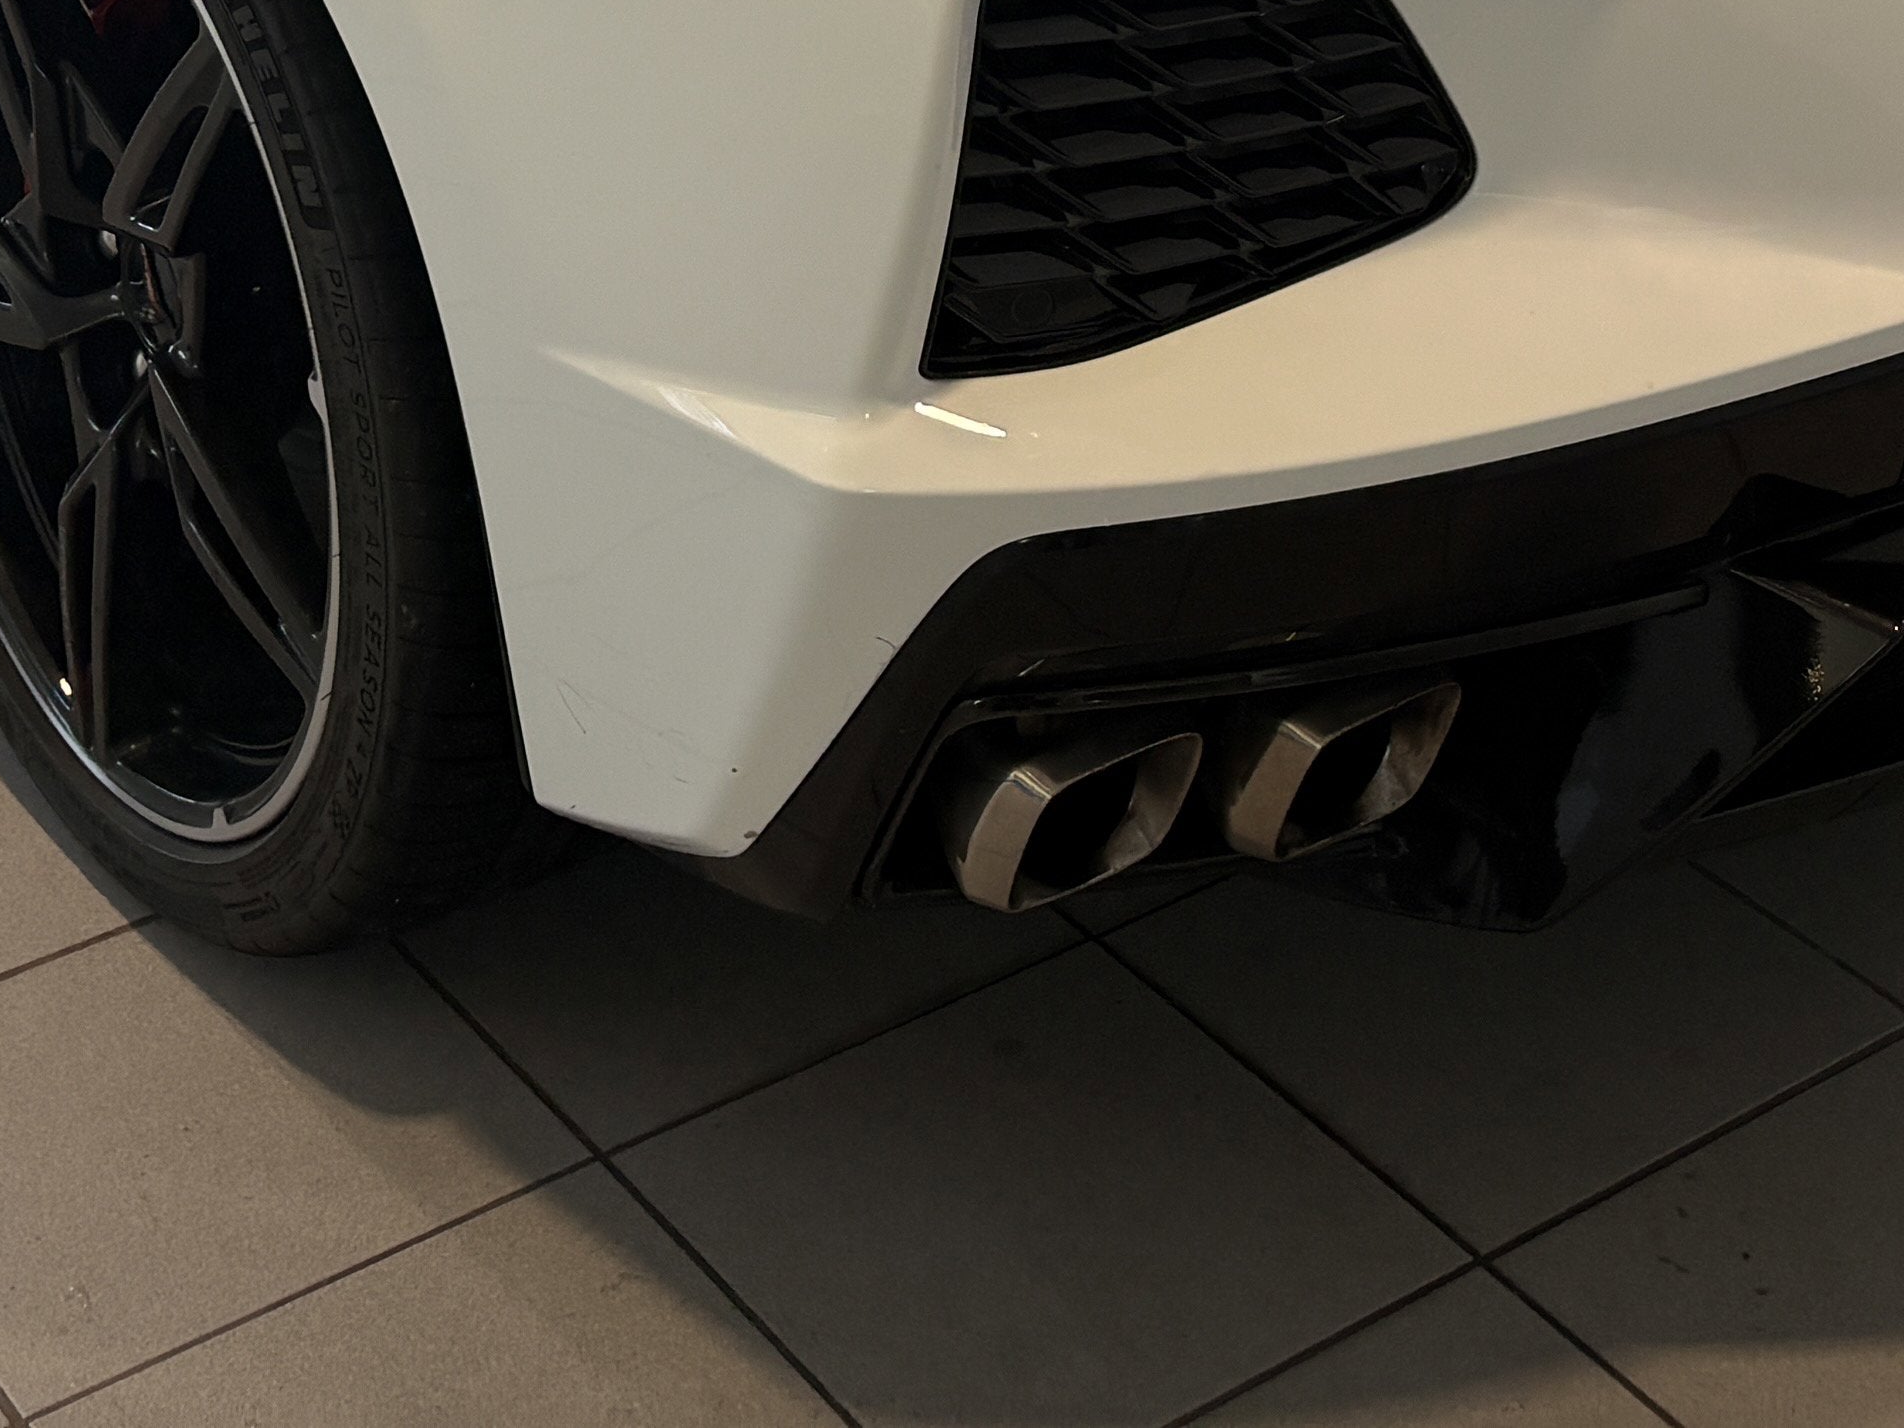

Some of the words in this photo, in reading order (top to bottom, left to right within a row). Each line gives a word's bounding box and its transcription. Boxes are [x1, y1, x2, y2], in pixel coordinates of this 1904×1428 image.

[324, 265, 363, 376] PILOT
[349, 389, 380, 517] SPORT
[364, 526, 384, 588] ALL
[356, 603, 383, 738] SEASON
